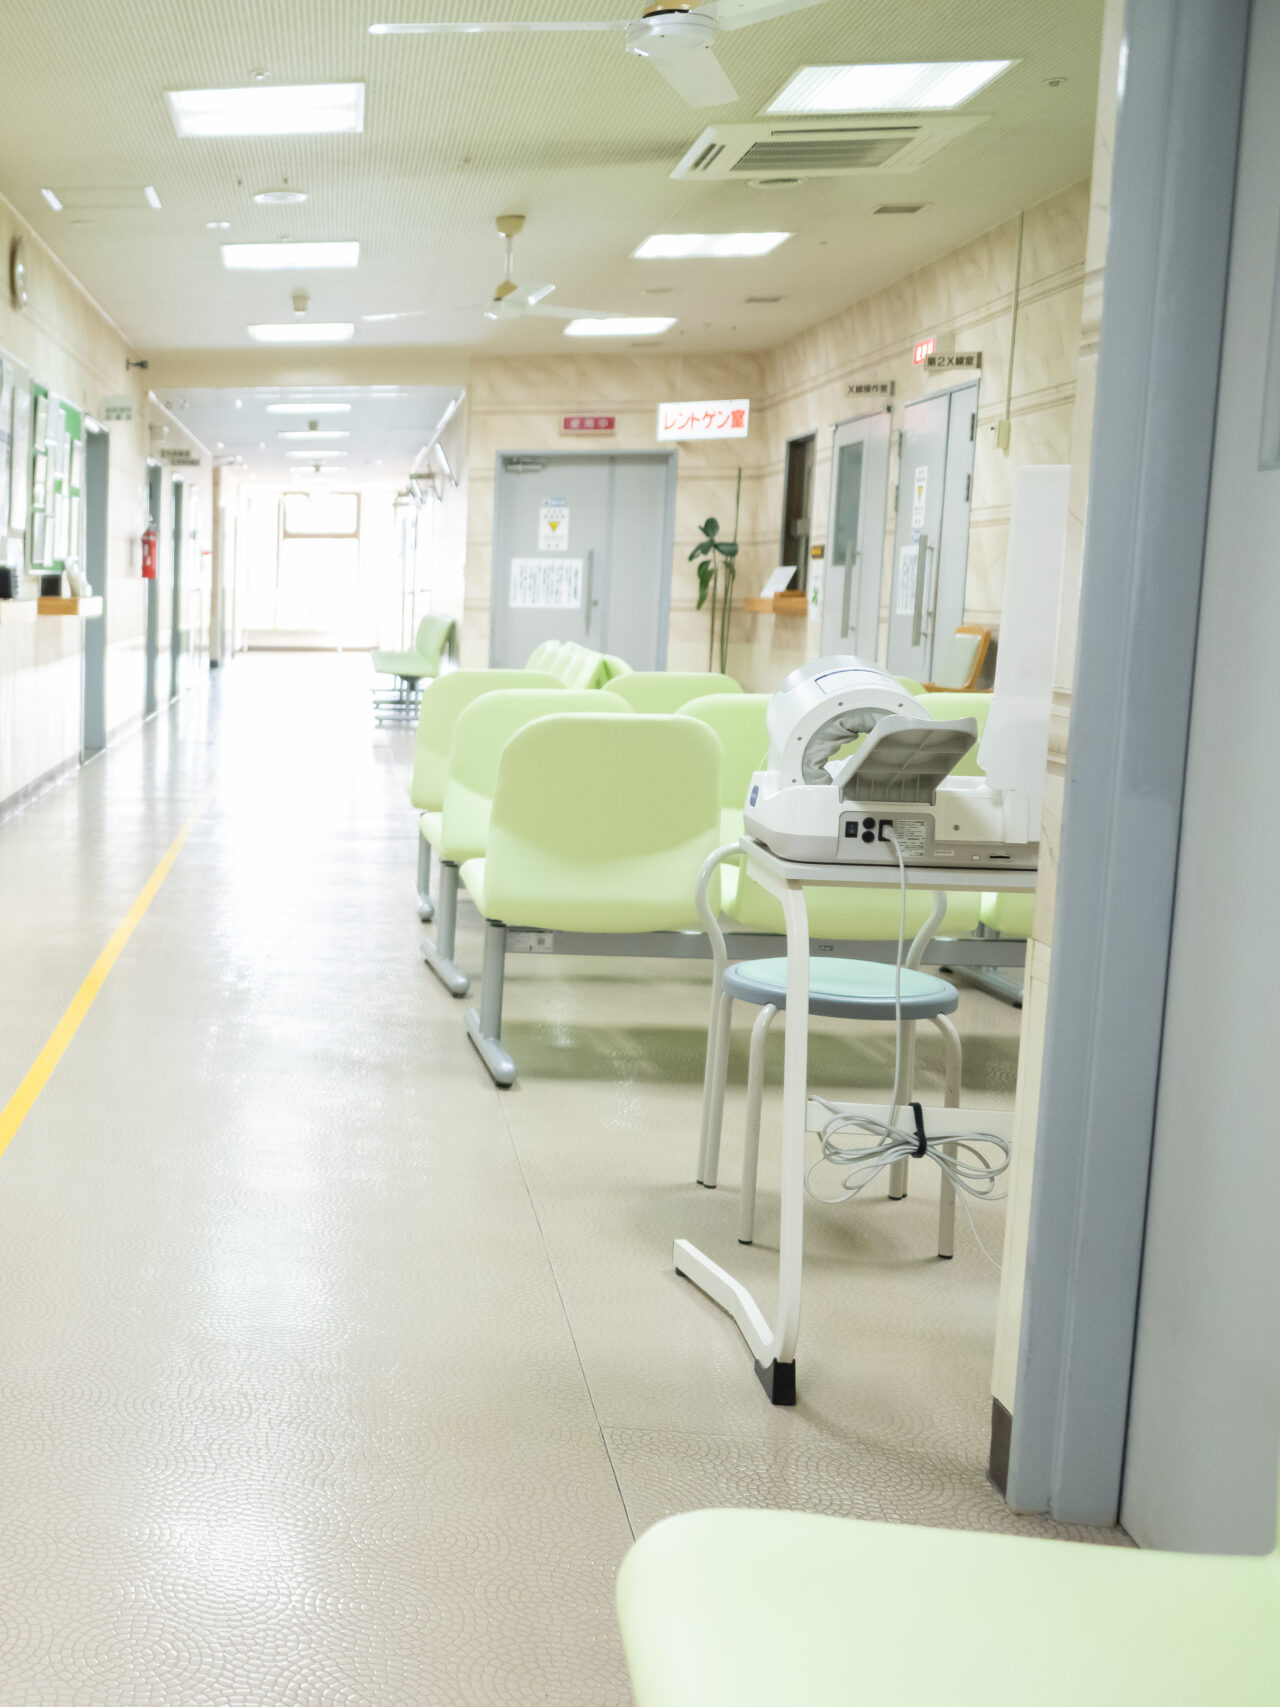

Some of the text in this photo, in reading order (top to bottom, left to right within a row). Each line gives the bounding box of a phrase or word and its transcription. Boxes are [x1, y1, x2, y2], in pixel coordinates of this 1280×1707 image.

[664, 409, 746, 430] レントゲン室
